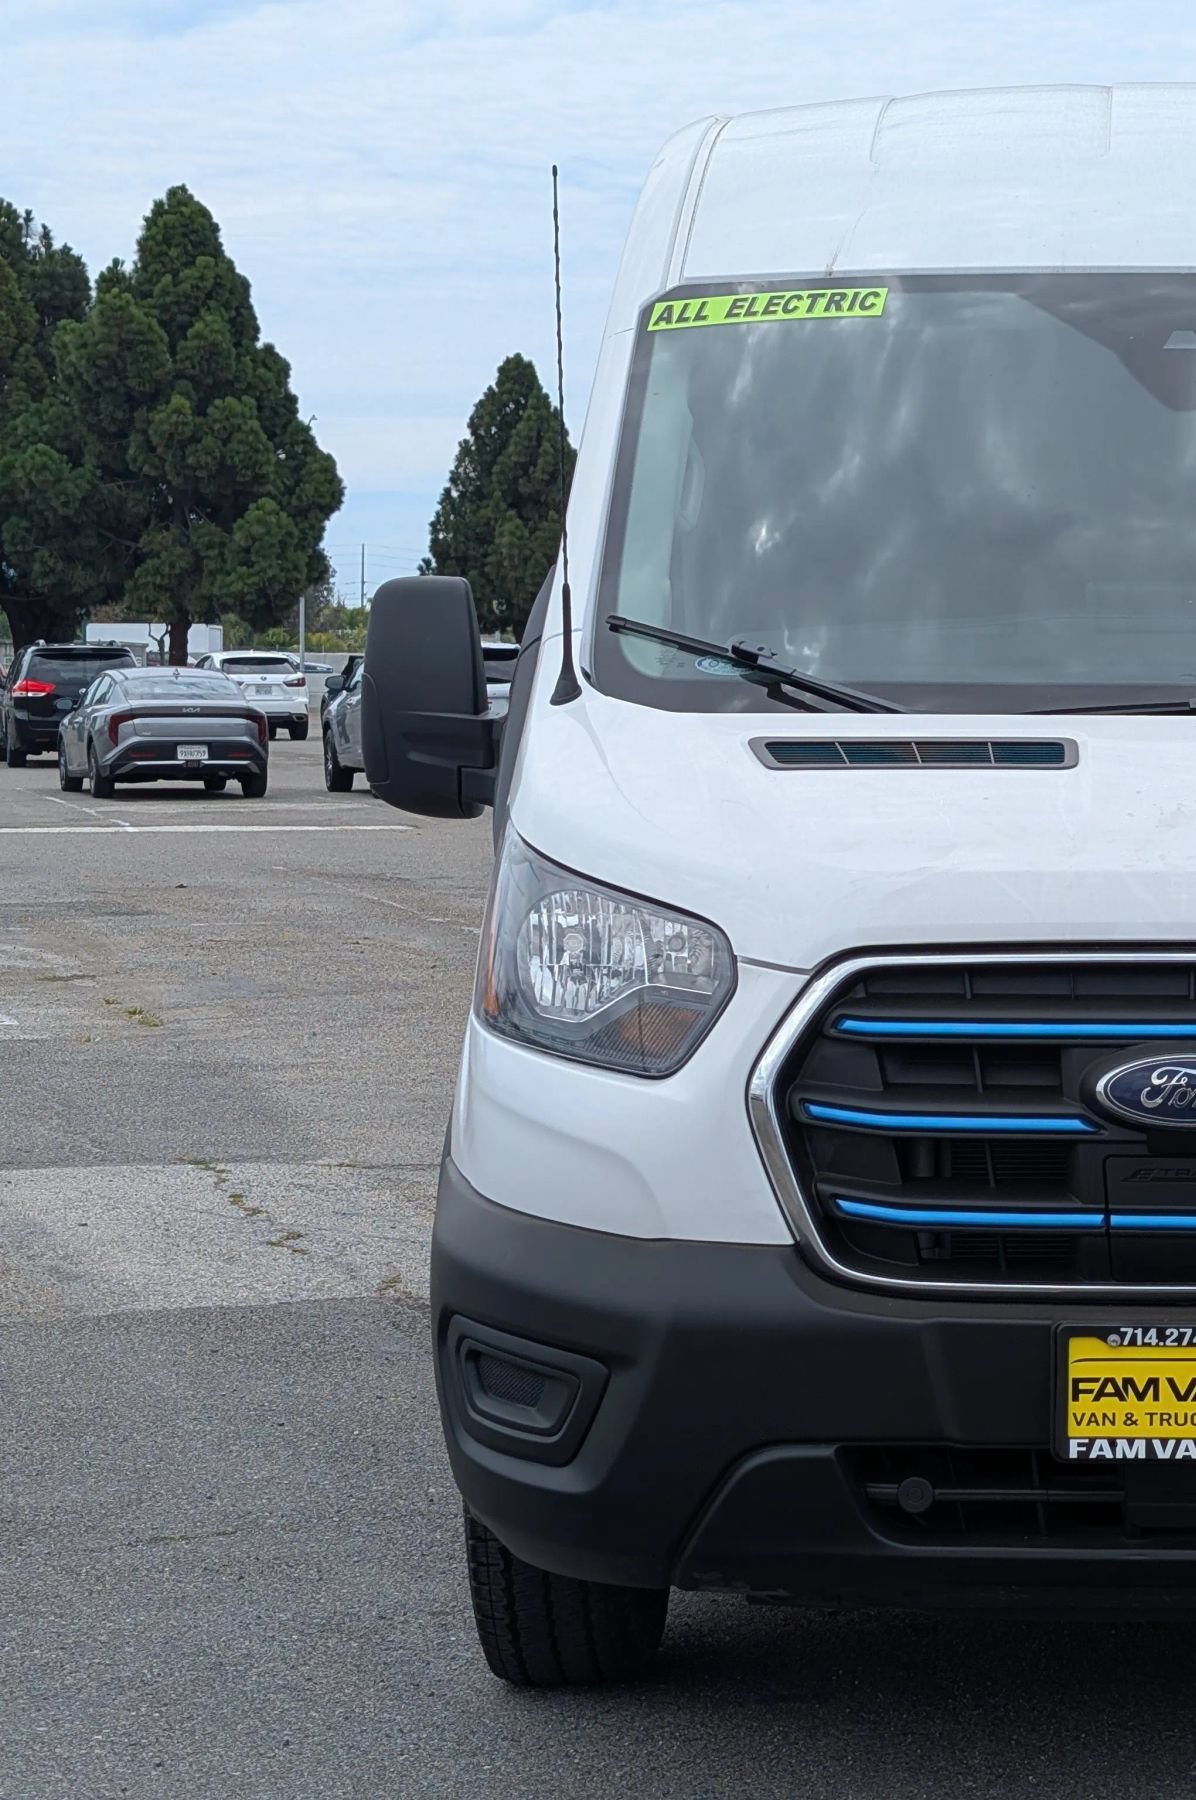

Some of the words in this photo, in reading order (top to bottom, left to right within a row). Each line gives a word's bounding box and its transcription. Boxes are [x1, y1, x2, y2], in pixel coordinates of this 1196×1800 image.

[652, 300, 710, 327] ALL
[723, 289, 882, 319] ELECTRIC
[1071, 1376, 1160, 1402] FAM
[1072, 1411, 1117, 1427] VAN
[1122, 1411, 1139, 1427] &
[1068, 1438, 1146, 1459] FAM
